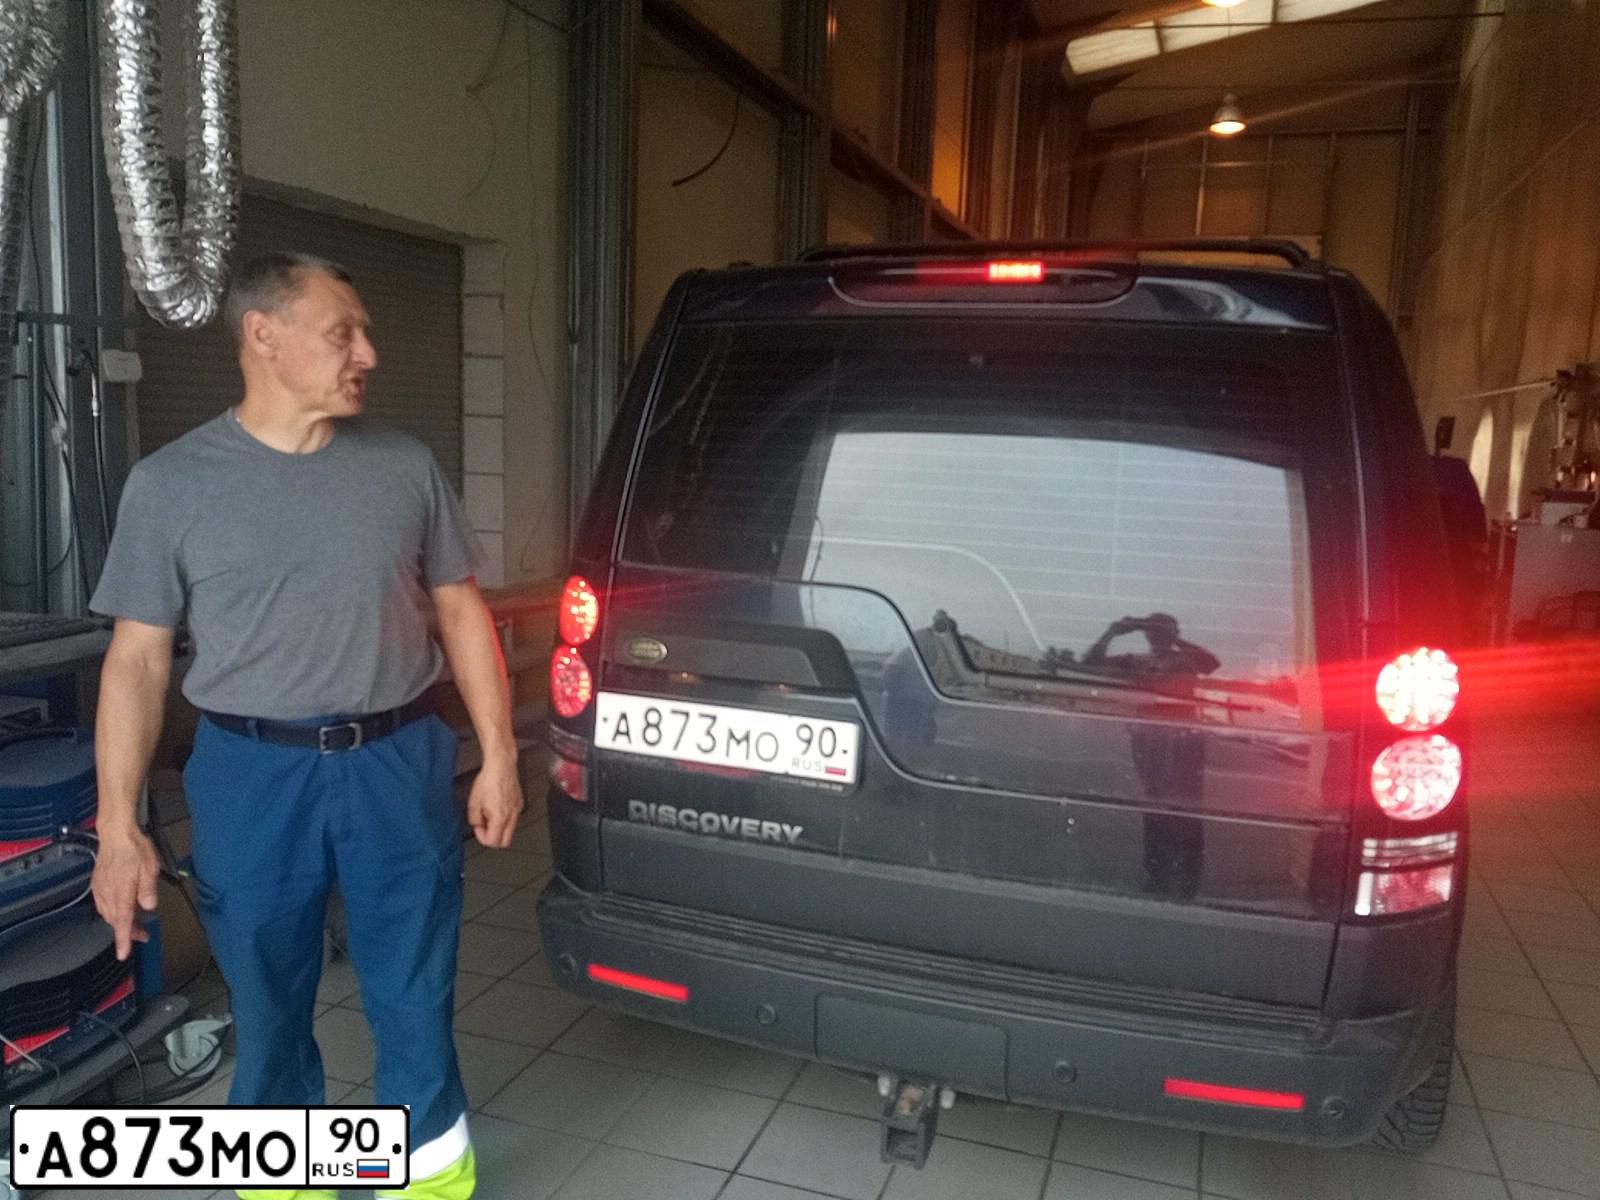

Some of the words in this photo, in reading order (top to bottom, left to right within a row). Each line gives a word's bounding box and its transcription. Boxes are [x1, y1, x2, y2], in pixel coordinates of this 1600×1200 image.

[795, 723, 837, 759] 90
[791, 757, 824, 774] RUS
[628, 799, 804, 844] DISCOVERY
